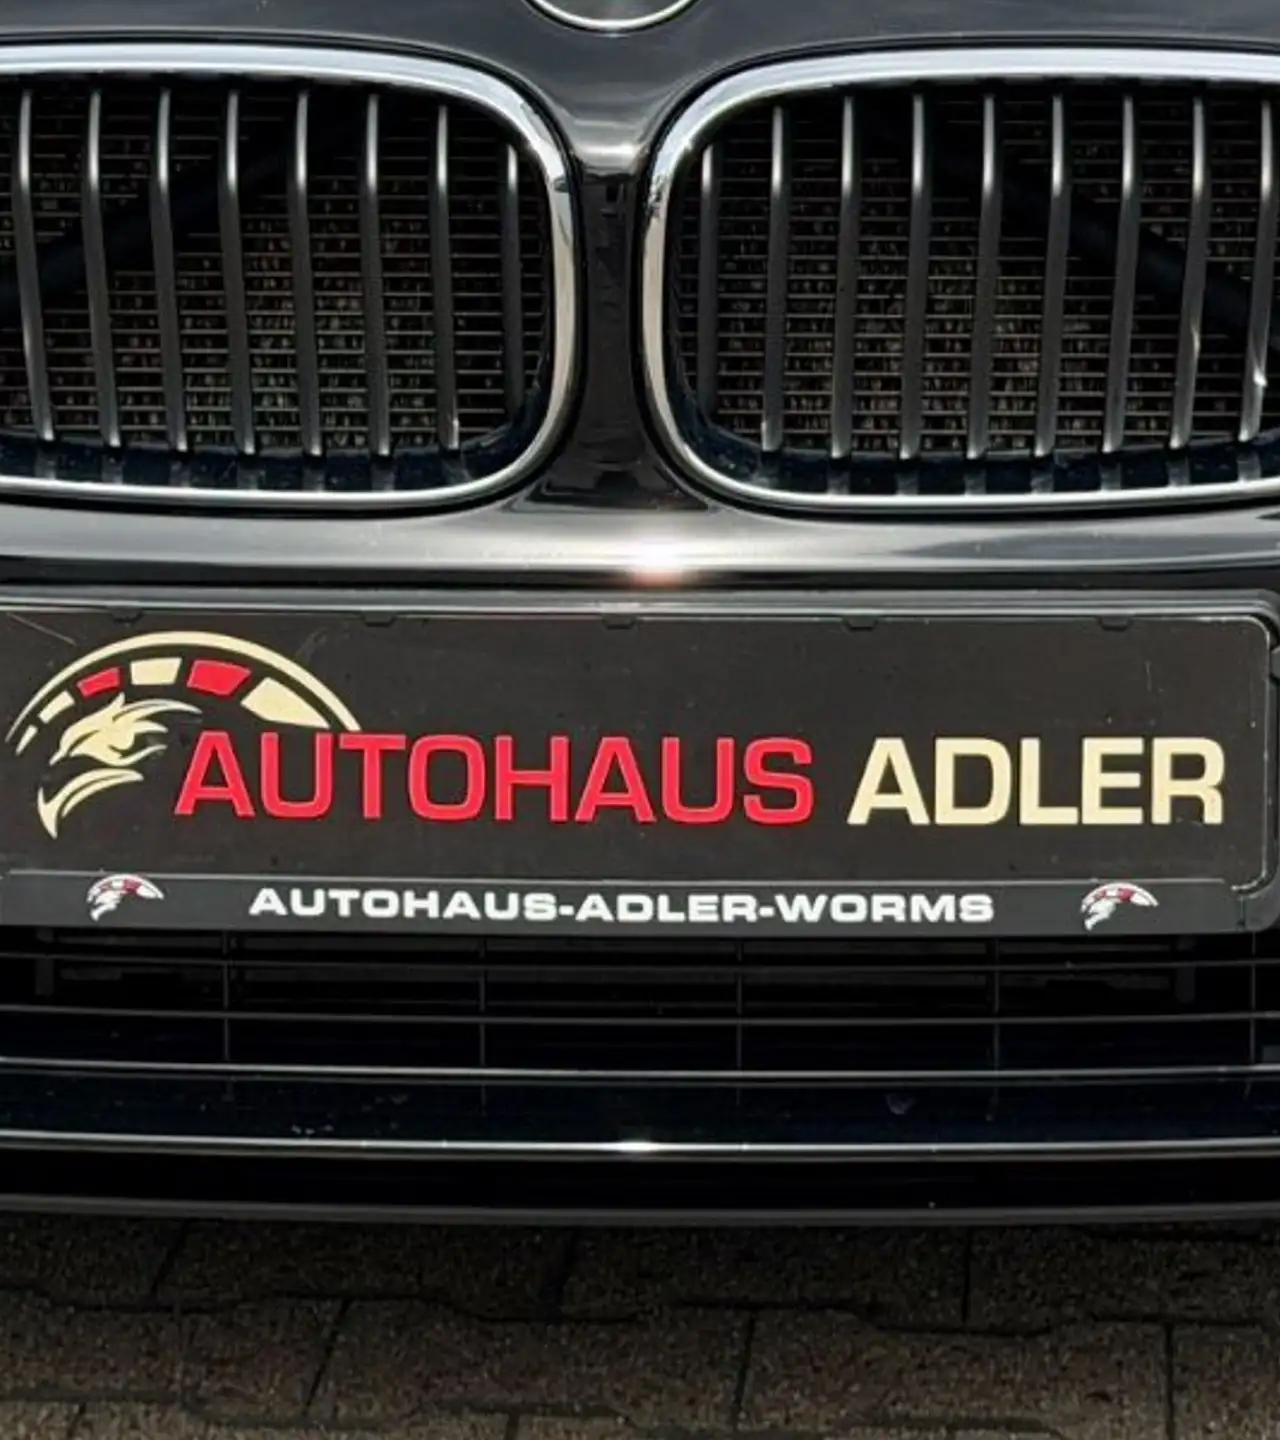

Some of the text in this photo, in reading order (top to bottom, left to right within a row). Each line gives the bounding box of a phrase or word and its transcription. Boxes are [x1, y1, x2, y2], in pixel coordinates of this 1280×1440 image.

[173, 730, 1226, 825] AUTOHAUS ADLER
[248, 888, 995, 923] AUTOHAUS-ADLER-WORMS
